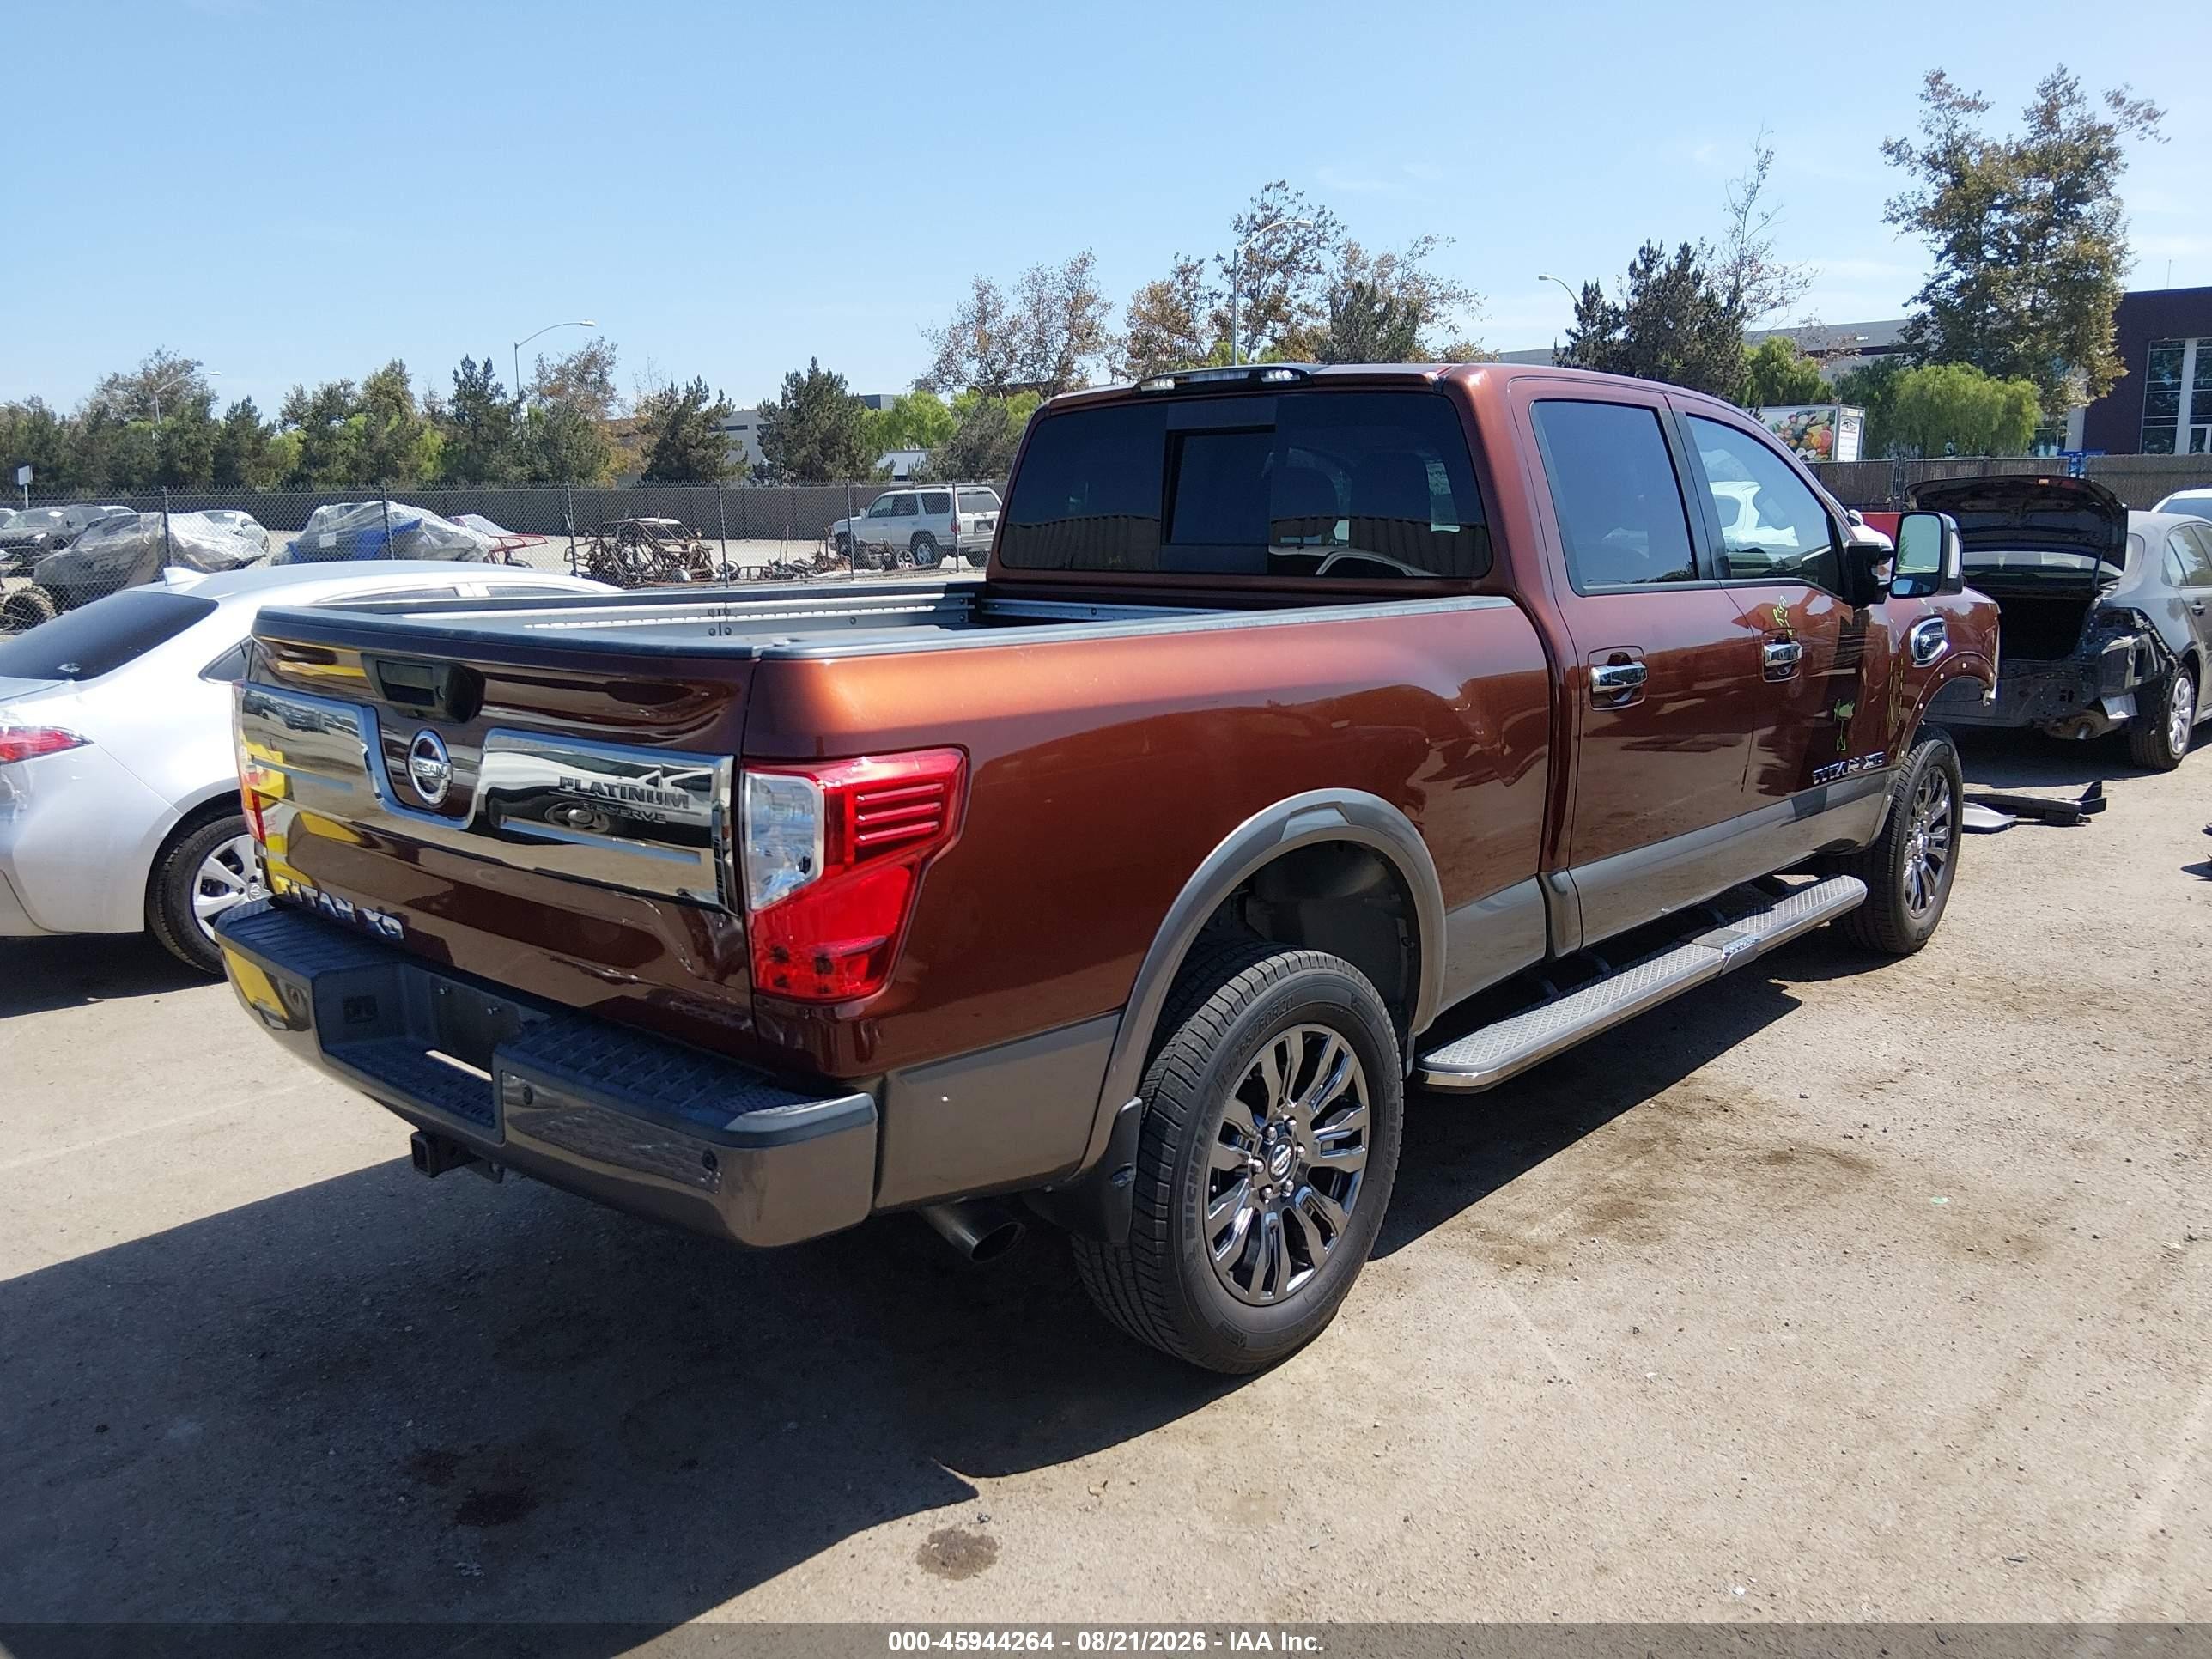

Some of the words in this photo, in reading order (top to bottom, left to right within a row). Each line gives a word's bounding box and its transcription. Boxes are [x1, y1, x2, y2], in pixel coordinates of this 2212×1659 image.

[559, 776, 690, 809] PLATINUM
[583, 802, 668, 824] RESERVE
[275, 874, 358, 923] TITAN
[362, 908, 405, 939] XD
